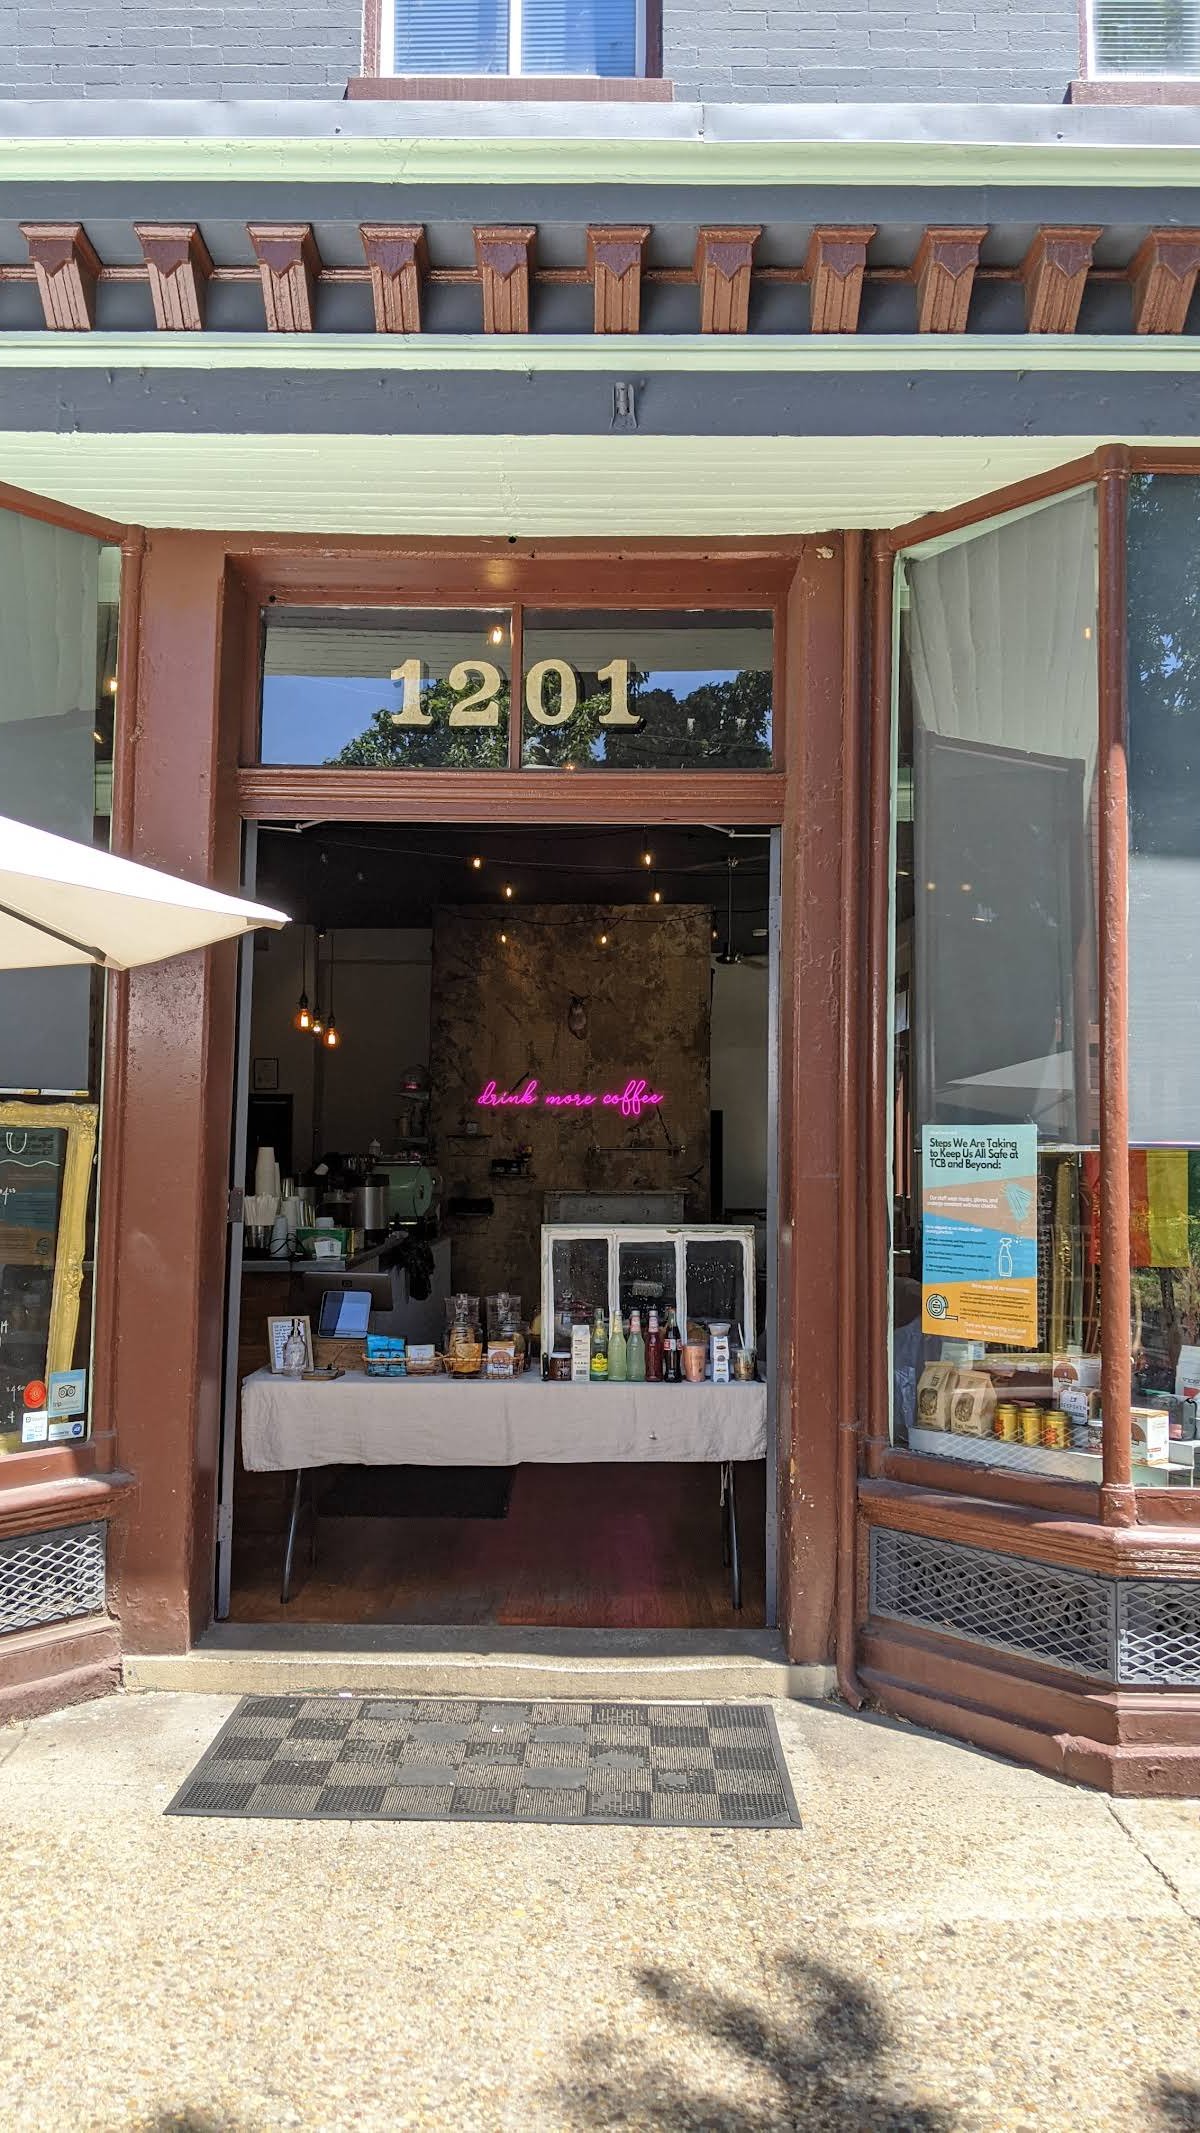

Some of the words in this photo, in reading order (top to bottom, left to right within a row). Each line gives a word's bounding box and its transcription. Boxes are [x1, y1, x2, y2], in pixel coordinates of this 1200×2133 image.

[390, 658, 641, 726] 1201
[478, 1080, 539, 1105] drink
[545, 1093, 597, 1105] more
[603, 1080, 664, 1115] coffee
[930, 1138, 951, 1149] Steps
[953, 1138, 967, 1147] We
[969, 1138, 986, 1148] Are
[987, 1138, 1017, 1151] Taking
[930, 1149, 938, 1157] to
[940, 1148, 961, 1159] Keep
[962, 1149, 973, 1158] Us
[974, 1148, 986, 1158] All
[988, 1148, 1008, 1159] Safe
[1009, 1150, 1019, 1159] at
[930, 1158, 946, 1168] TCB
[948, 1158, 963, 1168] and
[966, 1159, 1001, 1171] Beyond:
